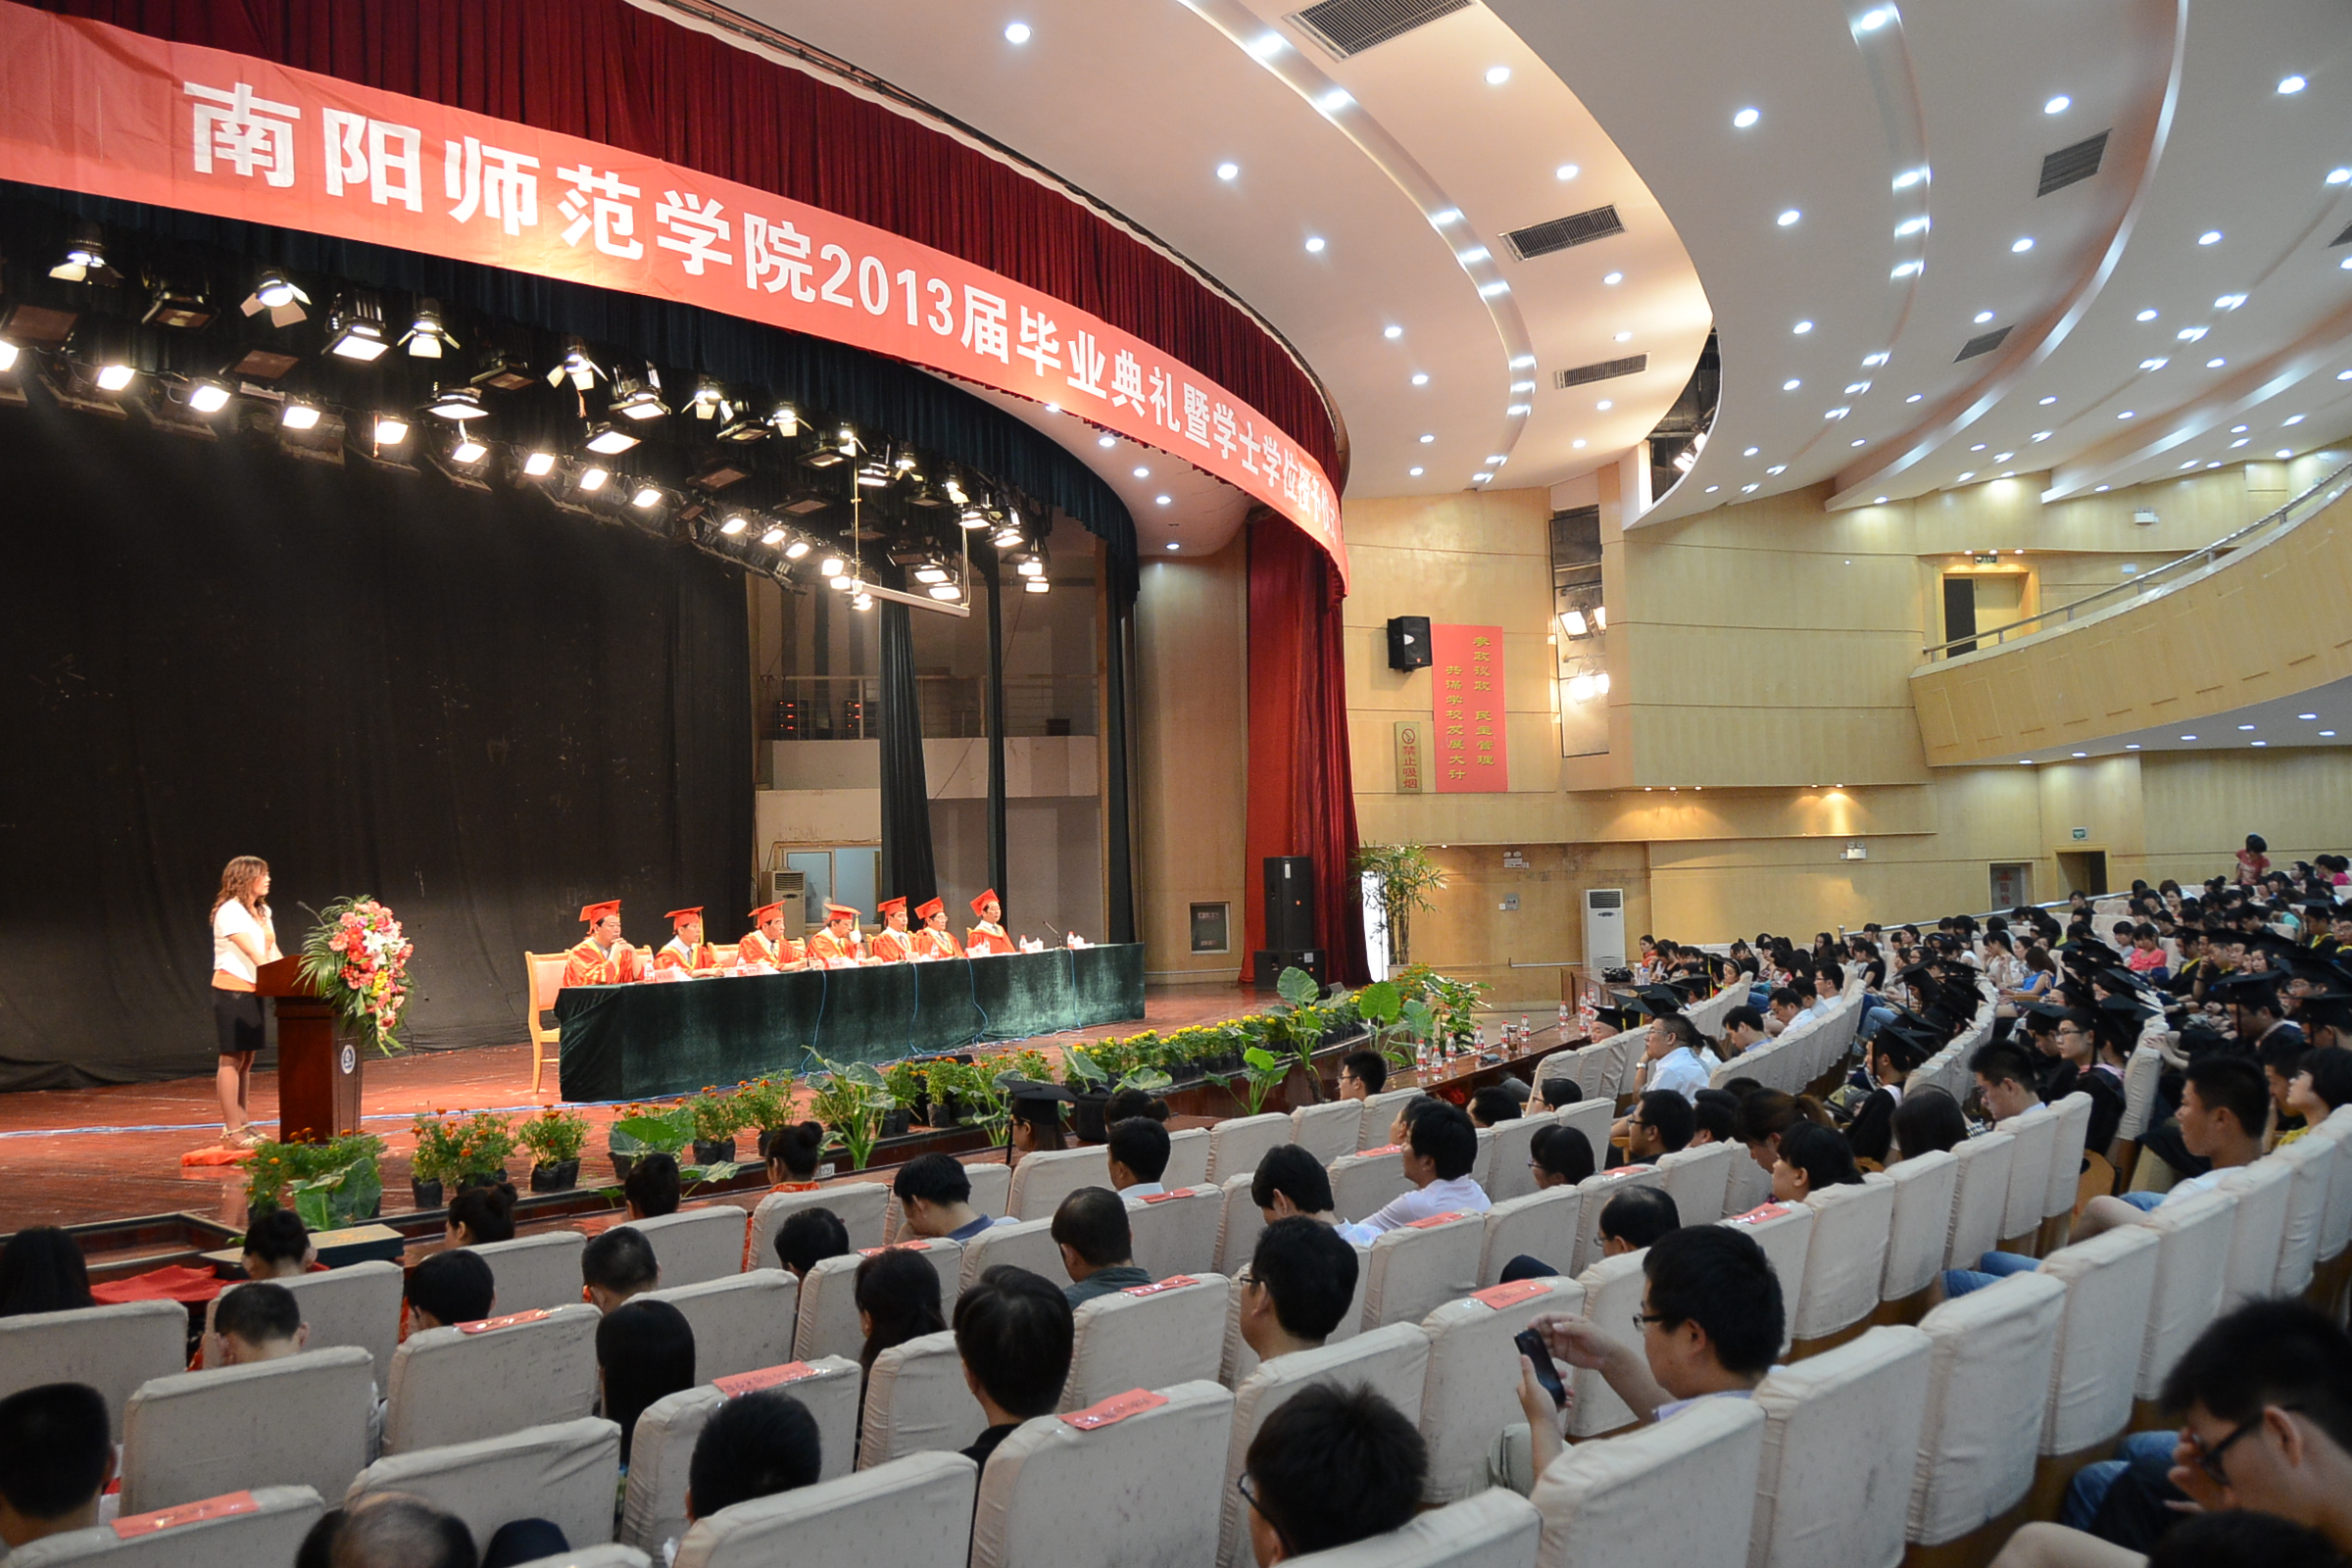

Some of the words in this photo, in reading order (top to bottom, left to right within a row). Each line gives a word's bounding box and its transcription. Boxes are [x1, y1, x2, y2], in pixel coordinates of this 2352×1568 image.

[1473, 636, 1492, 691] 参政议政
[1476, 710, 1494, 765] 民主管理
[1402, 745, 1418, 789] 禁止吸烟
